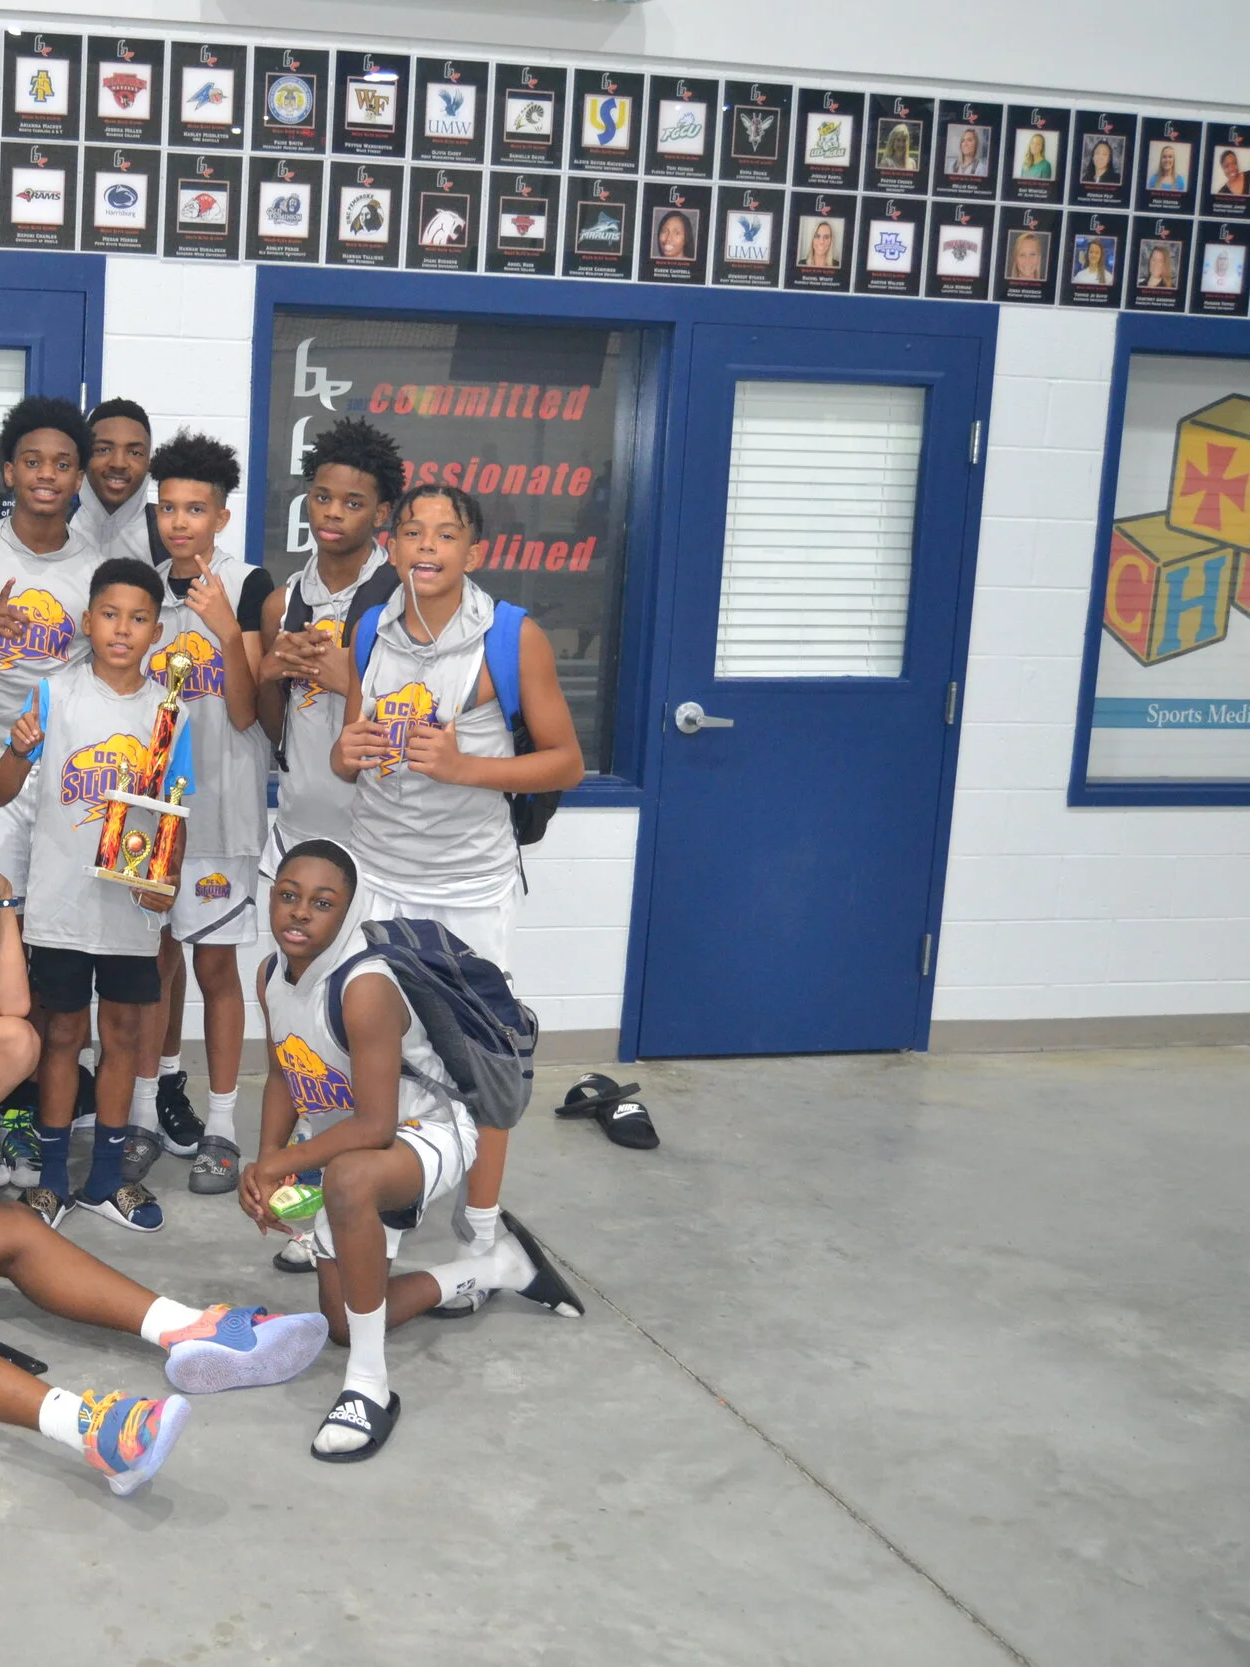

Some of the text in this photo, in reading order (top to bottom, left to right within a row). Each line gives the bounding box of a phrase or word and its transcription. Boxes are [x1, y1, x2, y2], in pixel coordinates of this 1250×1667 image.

[428, 119, 472, 136] UMW
[661, 124, 703, 142] FGCU
[31, 191, 62, 201] RAMS
[105, 209, 136, 218] Harrisburg
[727, 245, 768, 260] UMW
[369, 381, 591, 420] committed
[401, 456, 592, 496] assionate
[384, 700, 410, 717] DC
[1146, 703, 1203, 728] Sports
[94, 750, 117, 765] DC
[617, 1103, 640, 1113] NIKE
[328, 1409, 372, 1430] adidas
